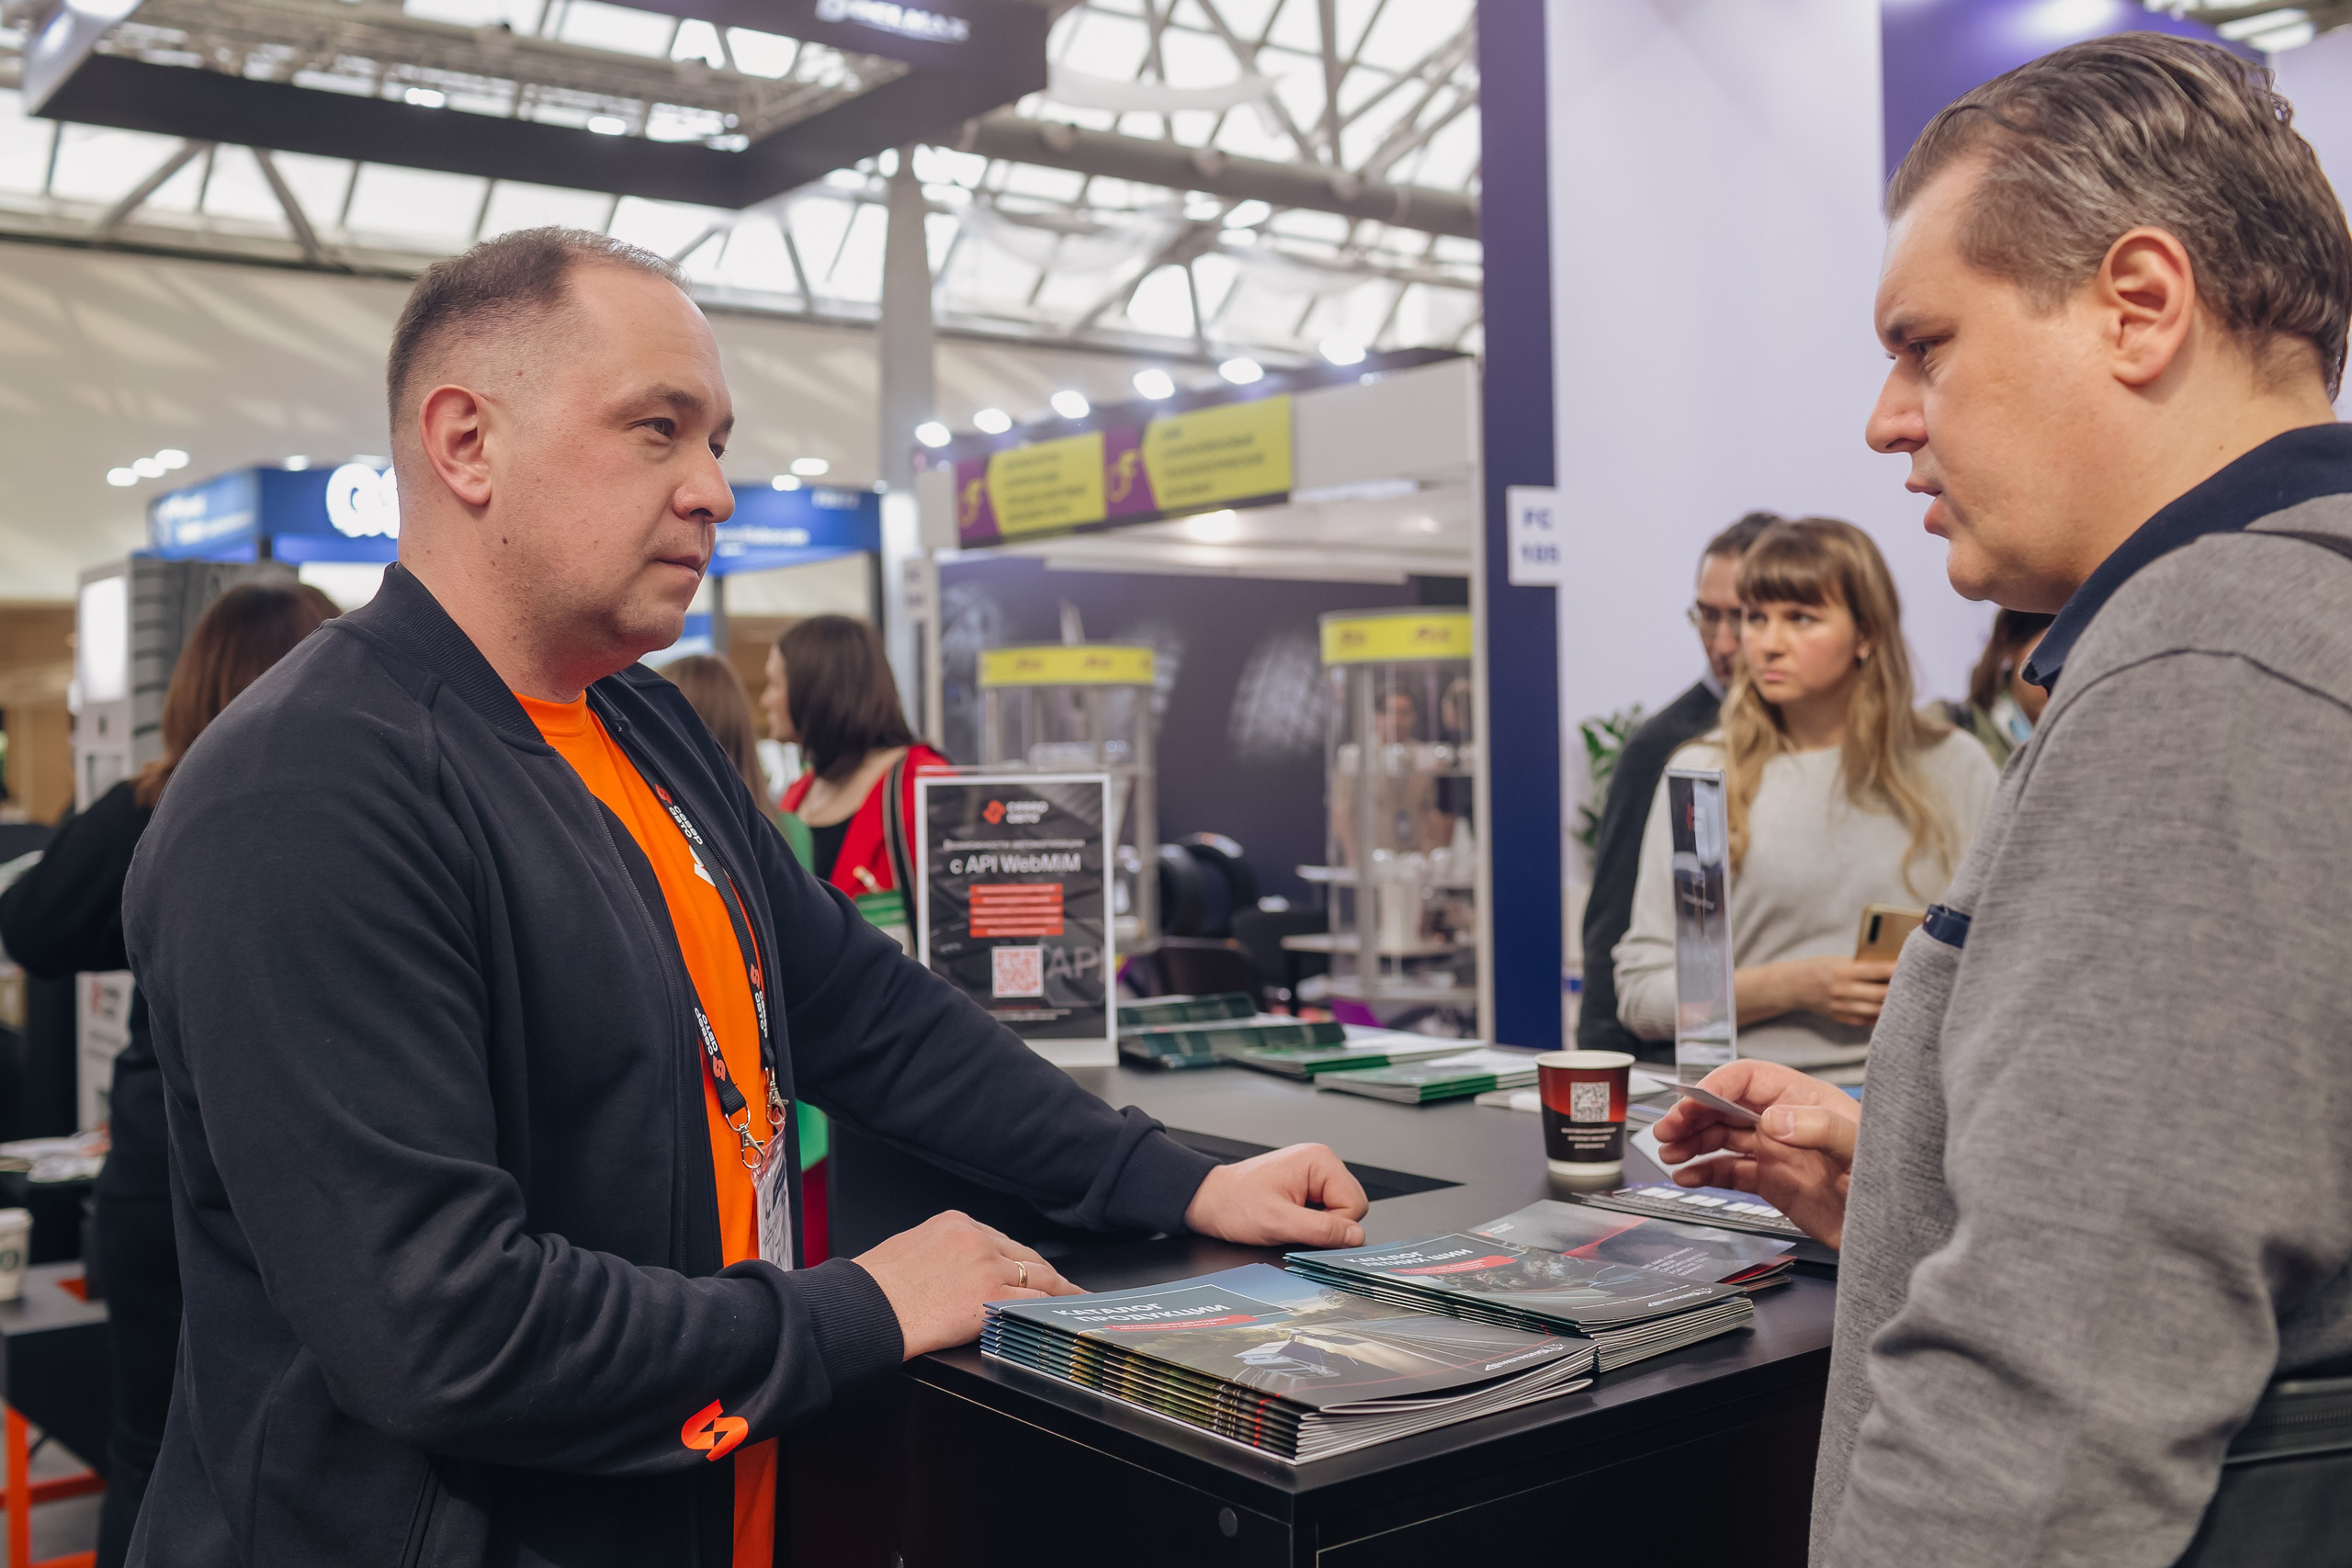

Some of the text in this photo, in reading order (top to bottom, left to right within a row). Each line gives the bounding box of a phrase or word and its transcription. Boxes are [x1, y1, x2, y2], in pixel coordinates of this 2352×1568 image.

[965, 853, 998, 874] API
[1343, 1251, 1423, 1263] КАТАЛОГ
[1425, 1248, 1475, 1260] ШИН
[1051, 1303, 1163, 1316] КАТАЛОГ
[1073, 1303, 1232, 1323] ПРОДУКЦИИ
